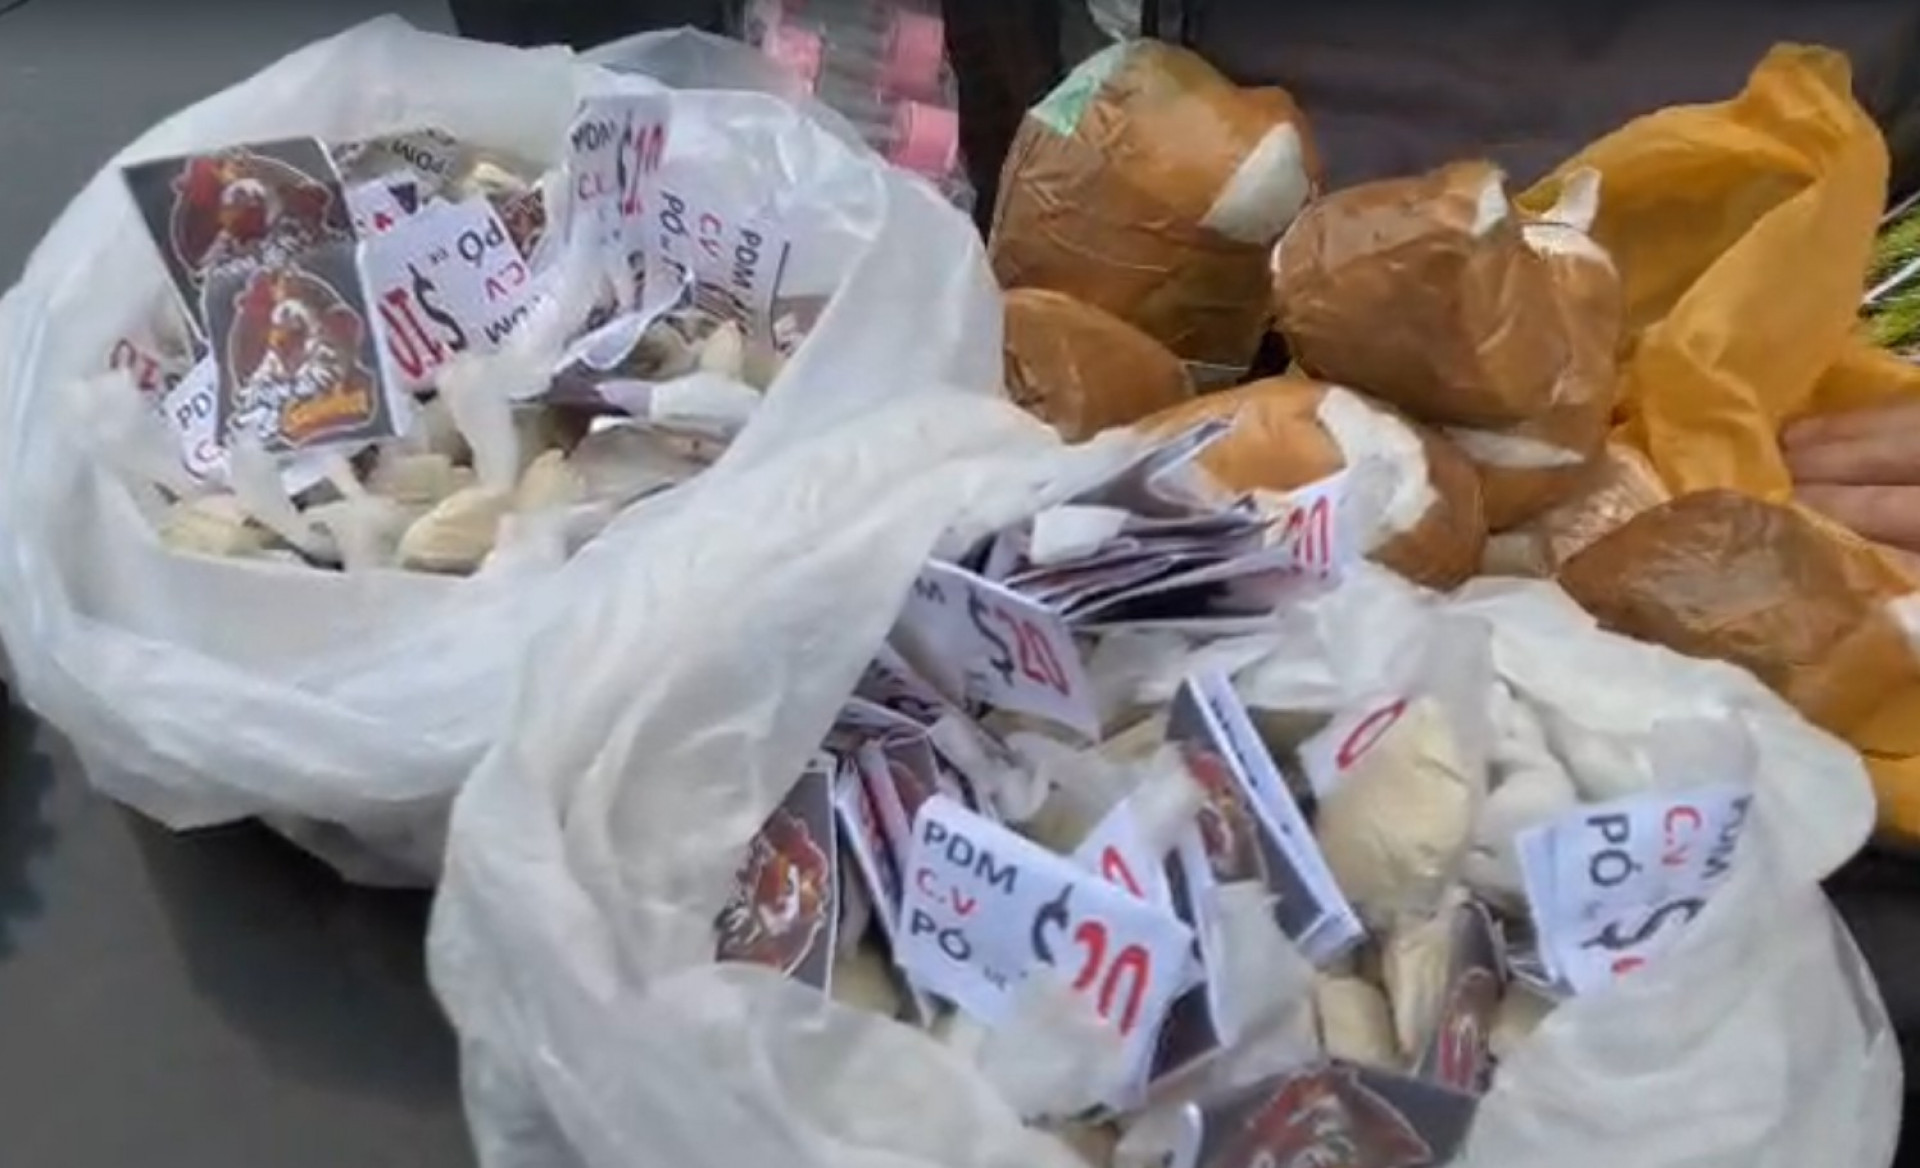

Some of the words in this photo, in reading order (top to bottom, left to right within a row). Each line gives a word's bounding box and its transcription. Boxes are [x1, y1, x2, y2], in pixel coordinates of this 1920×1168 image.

[457, 217, 506, 270] PÓ
[923, 820, 1018, 894] PDM
[1586, 812, 1643, 888] PÓ
[916, 867, 976, 917] C.V
[911, 907, 972, 961] PÓ
